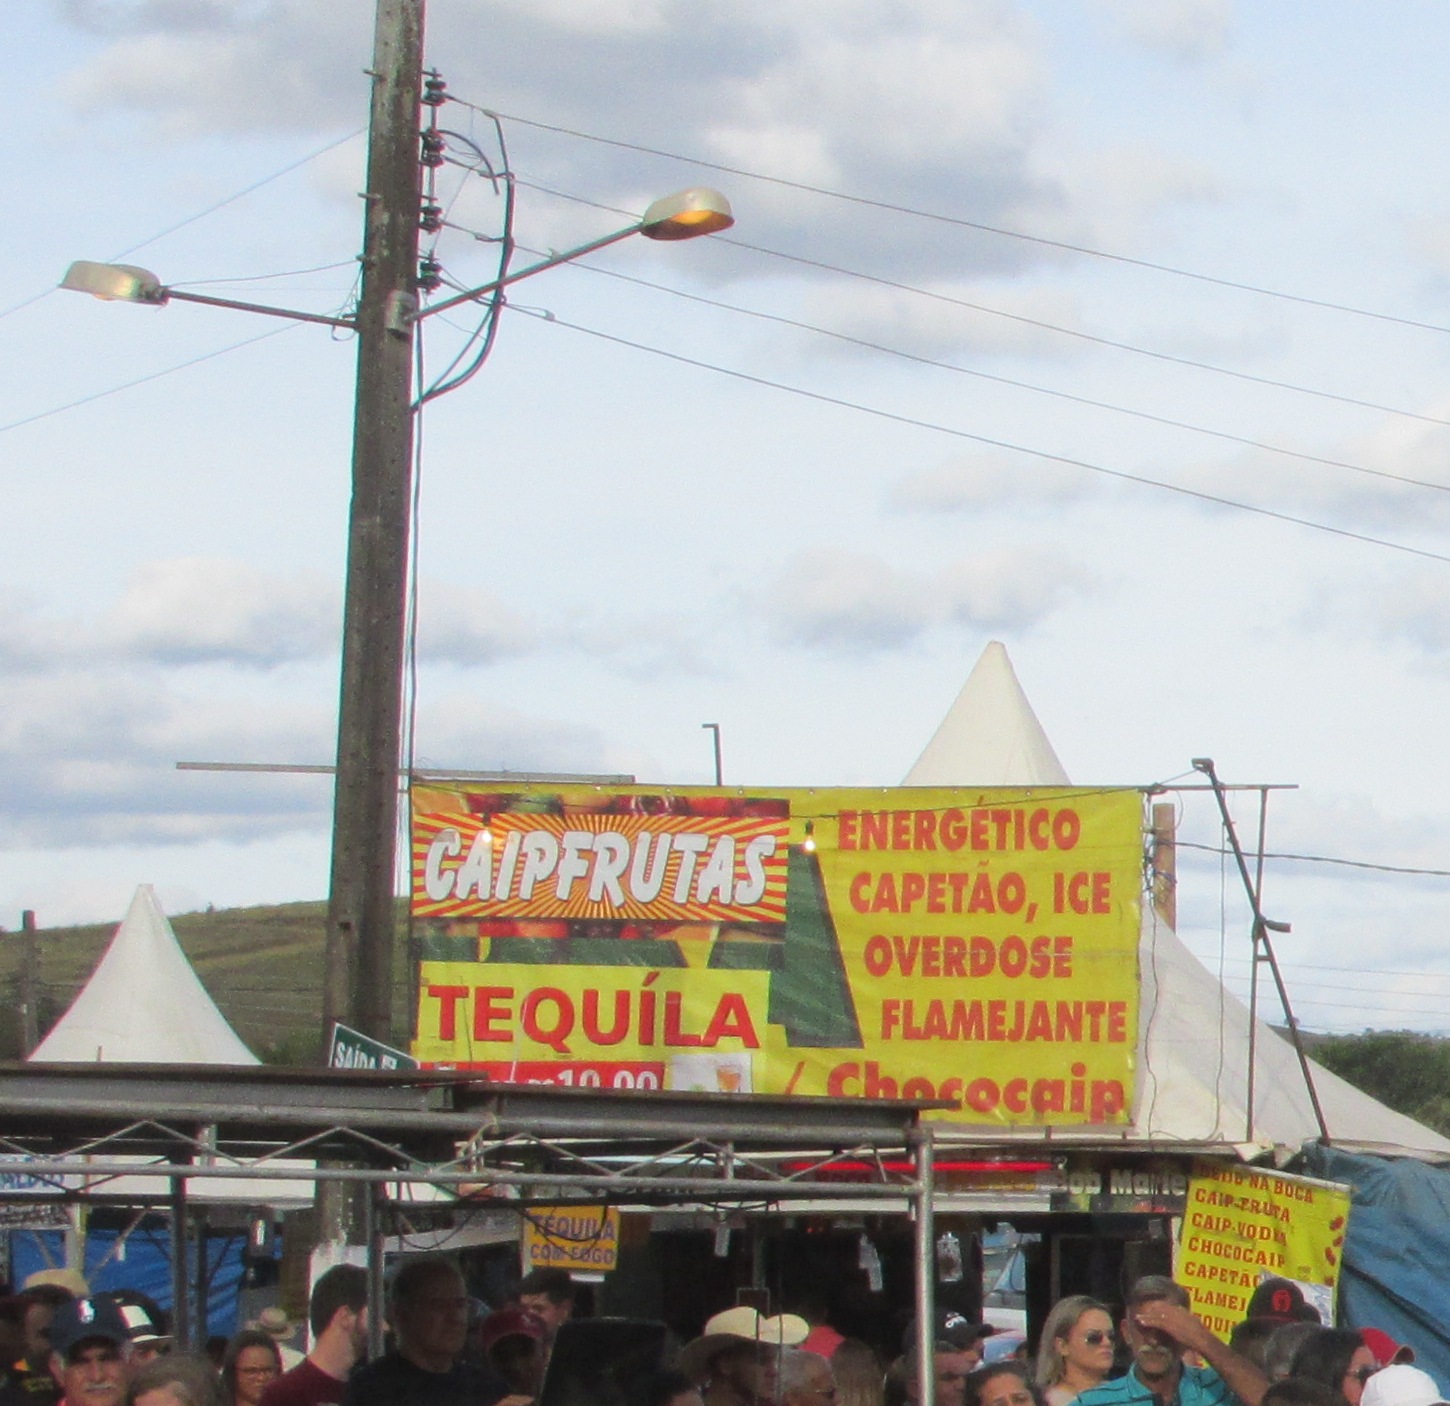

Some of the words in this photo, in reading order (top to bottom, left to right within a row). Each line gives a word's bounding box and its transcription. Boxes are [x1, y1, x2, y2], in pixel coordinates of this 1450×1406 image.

[838, 794, 1080, 850] ENERGÉTICO
[425, 828, 777, 907] CAIPFRUTAS
[850, 859, 1039, 923] CAPETÃO,
[1053, 872, 1111, 914] ICE
[863, 935, 1074, 978] OVERDOSE
[428, 971, 761, 1053] TEQUÍLA
[881, 999, 1128, 1043] FLAMEJANTE
[827, 1060, 1125, 1124] Chococaip
[1274, 1179, 1313, 1203] BOCA
[1188, 1236, 1286, 1268] CHOCOCAIP
